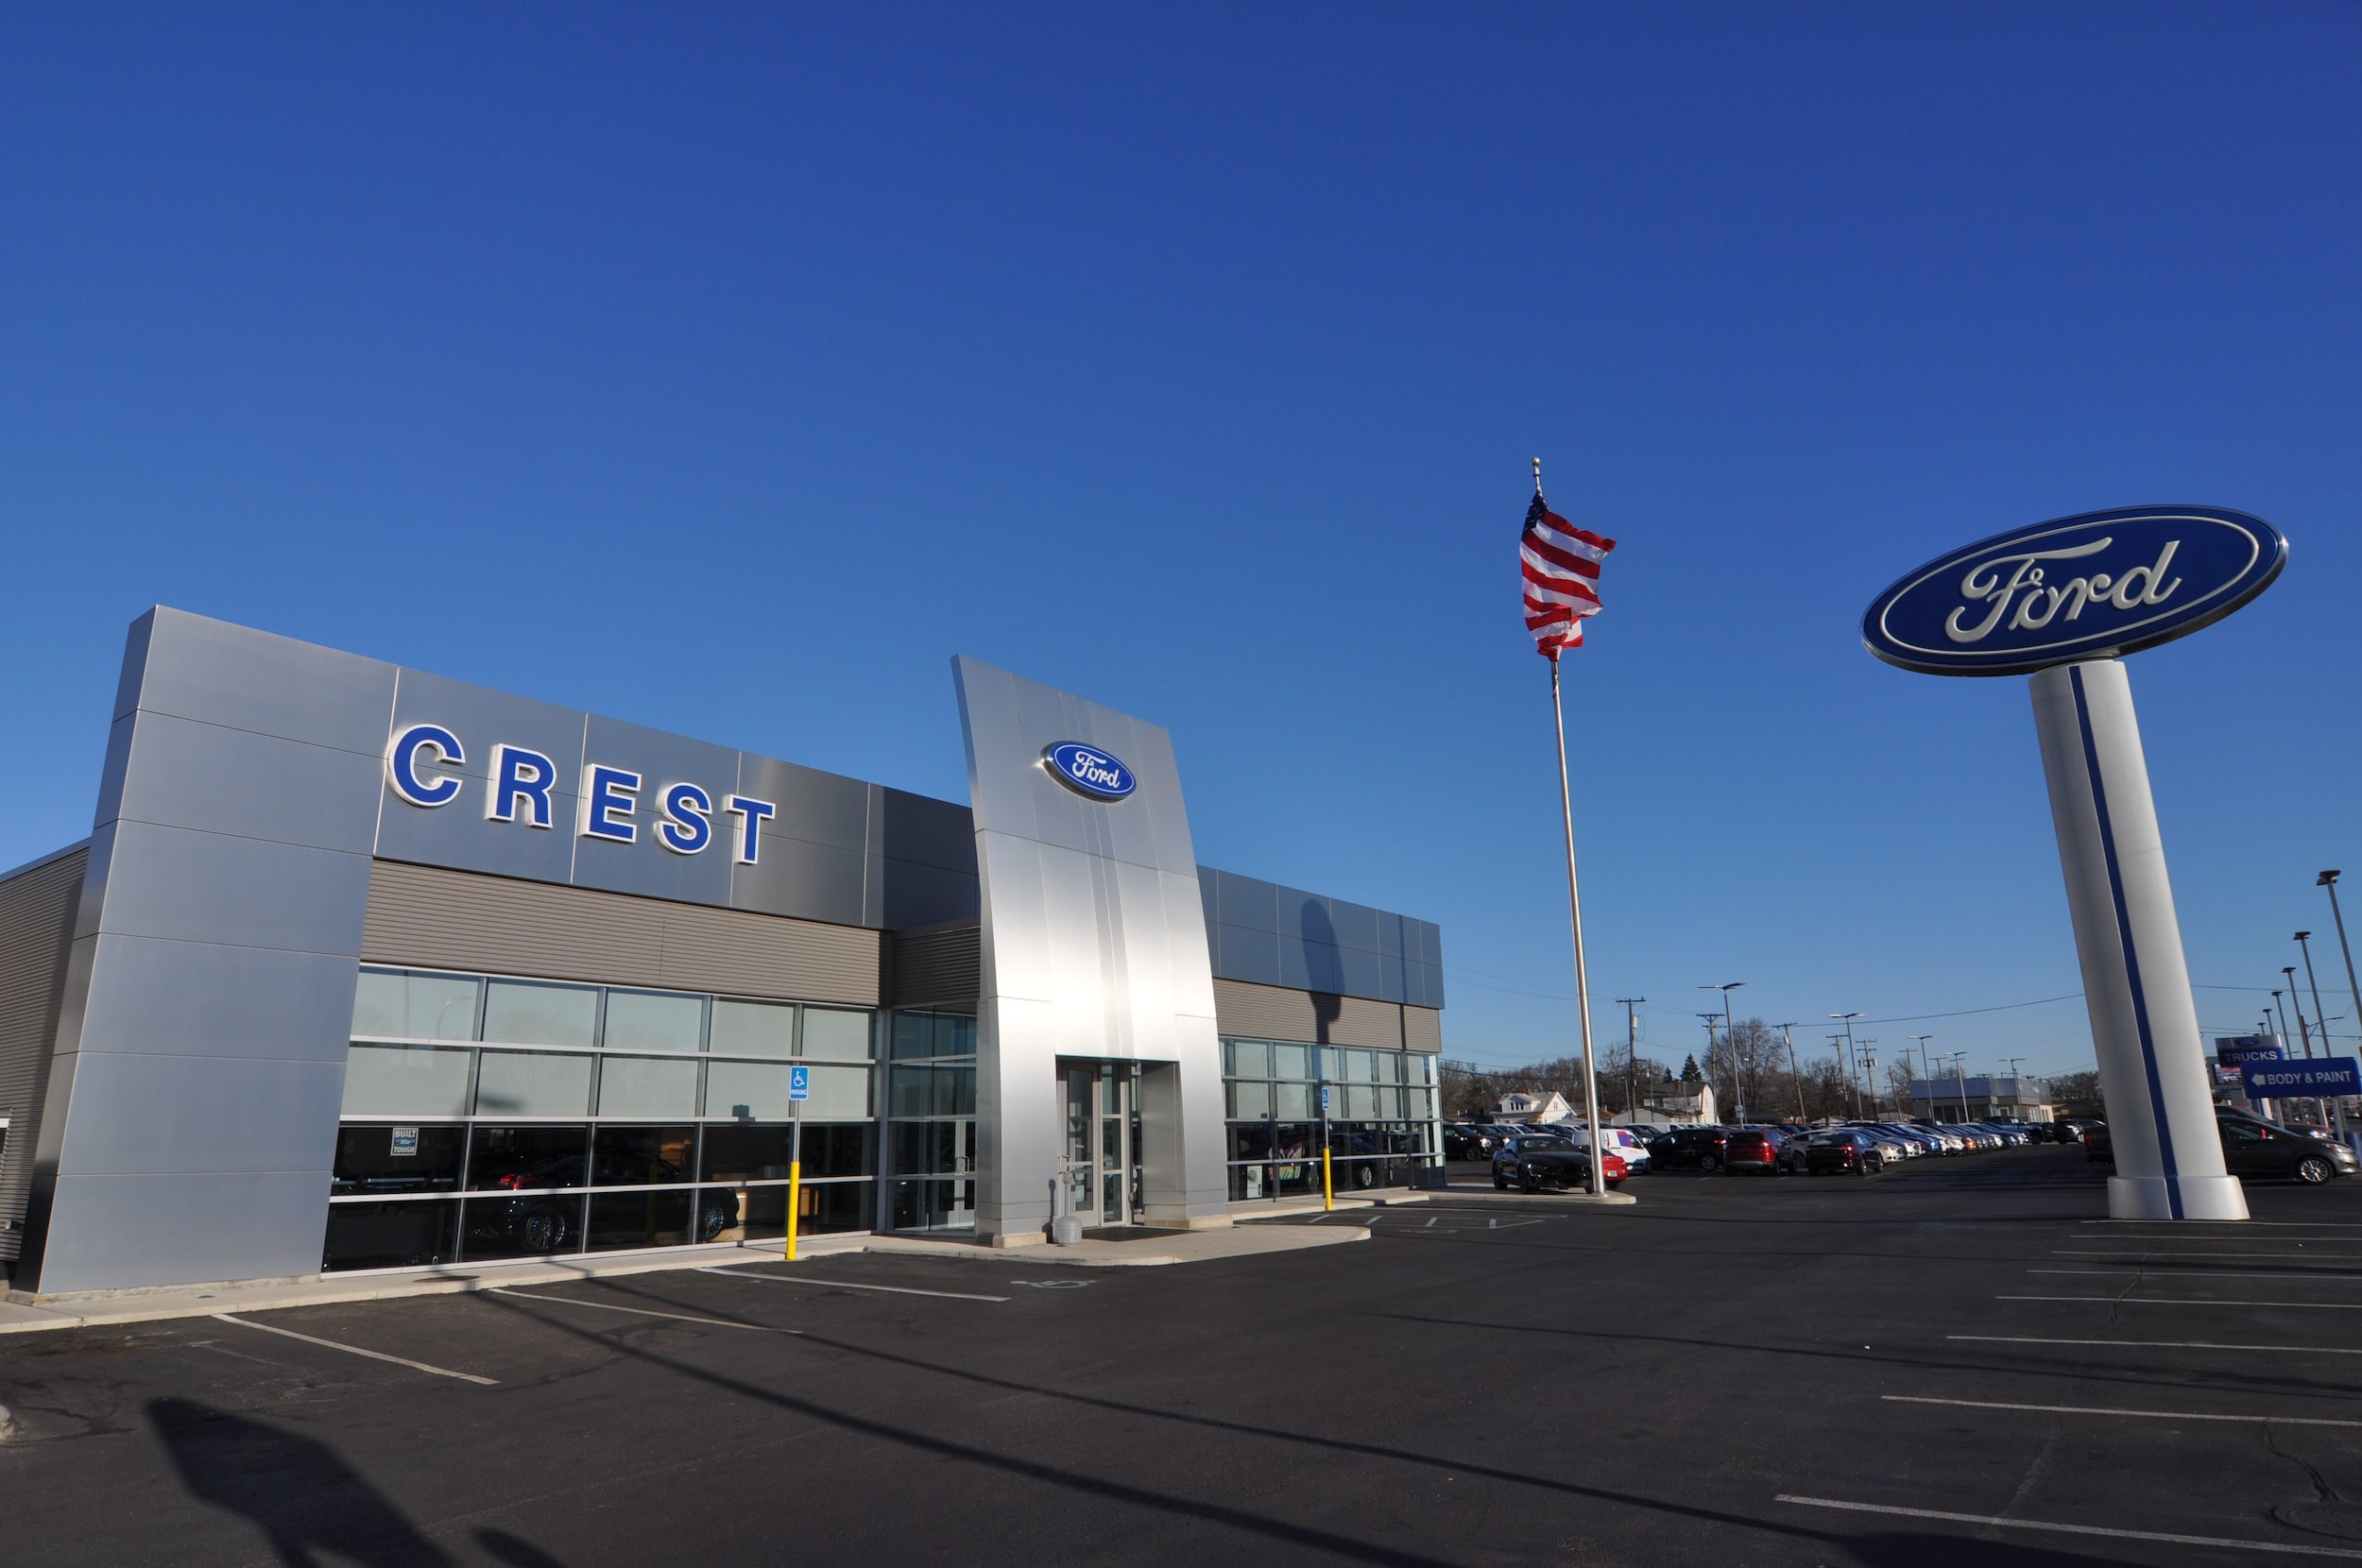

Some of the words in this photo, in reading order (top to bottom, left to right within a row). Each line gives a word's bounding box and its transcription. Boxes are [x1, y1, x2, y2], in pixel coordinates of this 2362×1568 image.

[1944, 537, 2182, 643] Ford
[1072, 751, 1121, 788] Ford
[387, 724, 776, 864] CREST
[2224, 1050, 2278, 1062] TRUCKS
[2268, 1073, 2302, 1084] BODY
[2304, 1072, 2314, 1083] &
[2316, 1071, 2352, 1082] PAINT
[395, 1130, 417, 1138] BUILT
